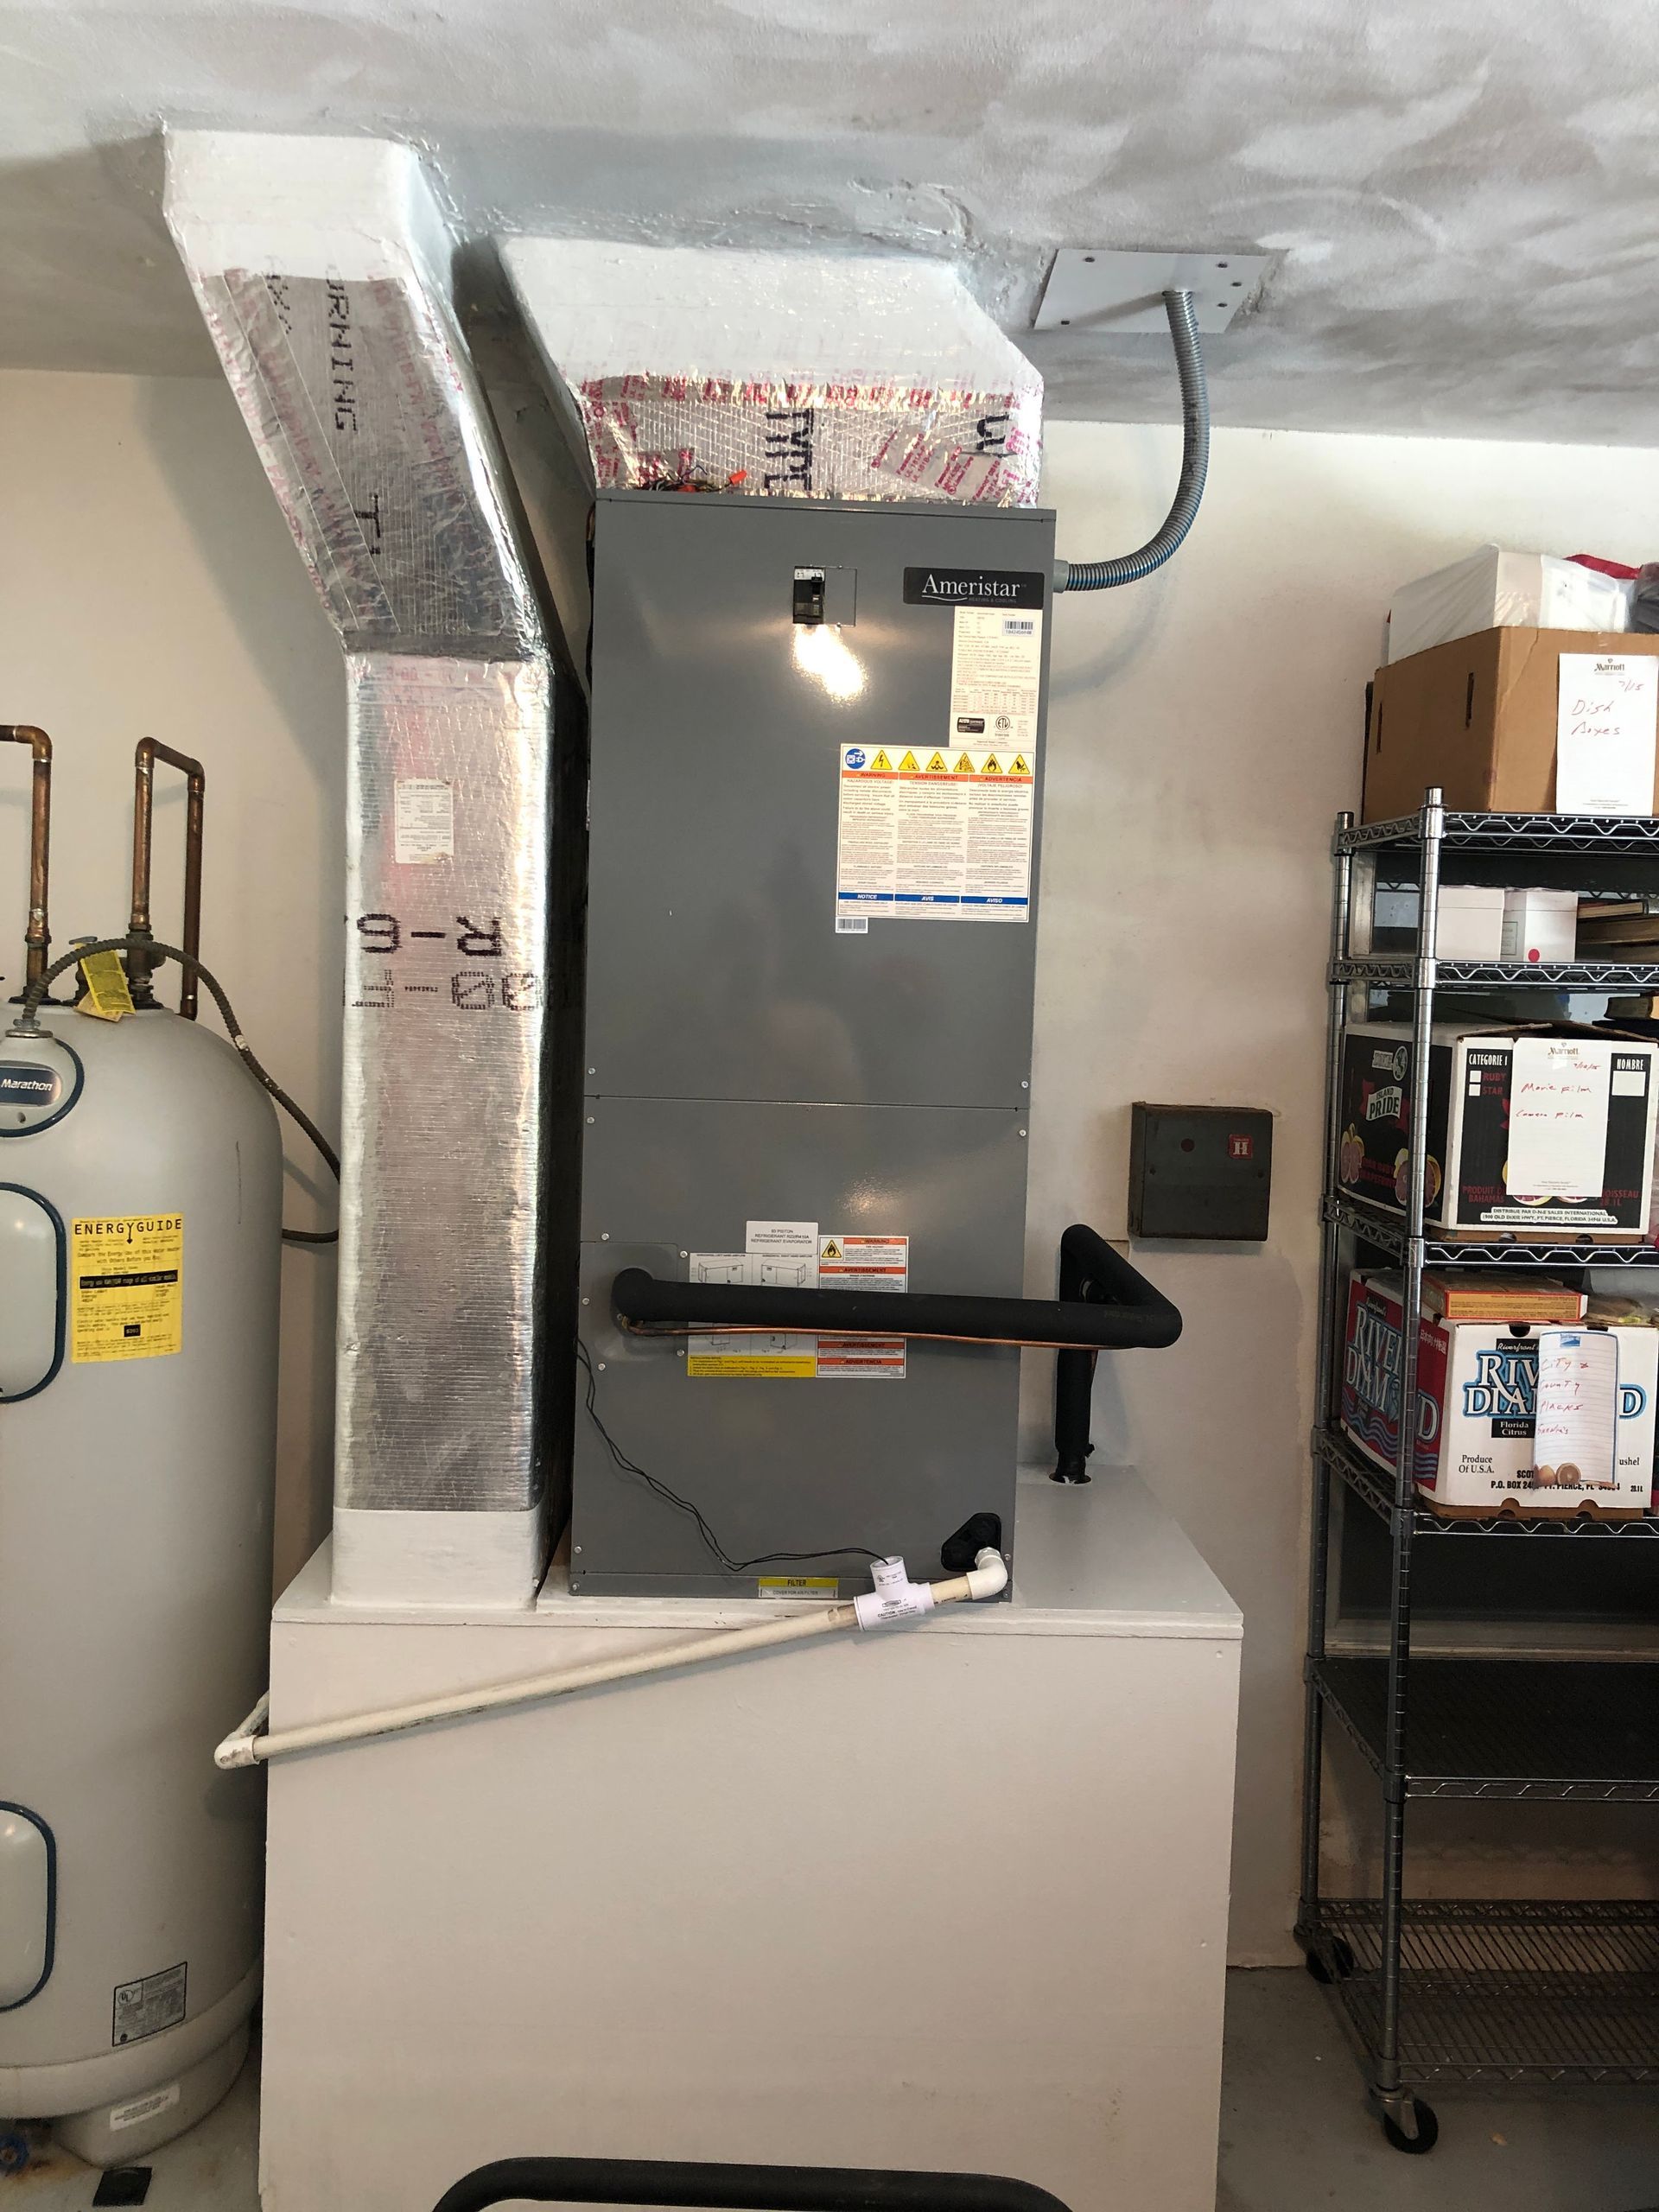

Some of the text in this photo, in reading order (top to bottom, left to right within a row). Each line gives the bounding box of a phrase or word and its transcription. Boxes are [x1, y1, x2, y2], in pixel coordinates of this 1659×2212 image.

[921, 573, 1020, 597] Ameristar
[1469, 1053, 1503, 1065] CATEGORIE
[1617, 1058, 1644, 1071] NOMBRE
[1483, 1072, 1507, 1082] RUBY
[1, 1077, 53, 1092] Marathon
[1482, 1086, 1503, 1095] STAR
[1369, 1096, 1399, 1119] PRIDE
[1232, 1141, 1249, 1155] H
[74, 1218, 182, 1237] ENERGYGUIDE
[1478, 1355, 1539, 1386] RIV
[1461, 1454, 1493, 1464] Produce
[1618, 1457, 1640, 1466] ushel
[1459, 1465, 1495, 1474] Of U.S.A.
[1516, 1470, 1535, 1478] SCOT
[1491, 1480, 1505, 1489] P.O.
[787, 1579, 807, 1587] FILTER
